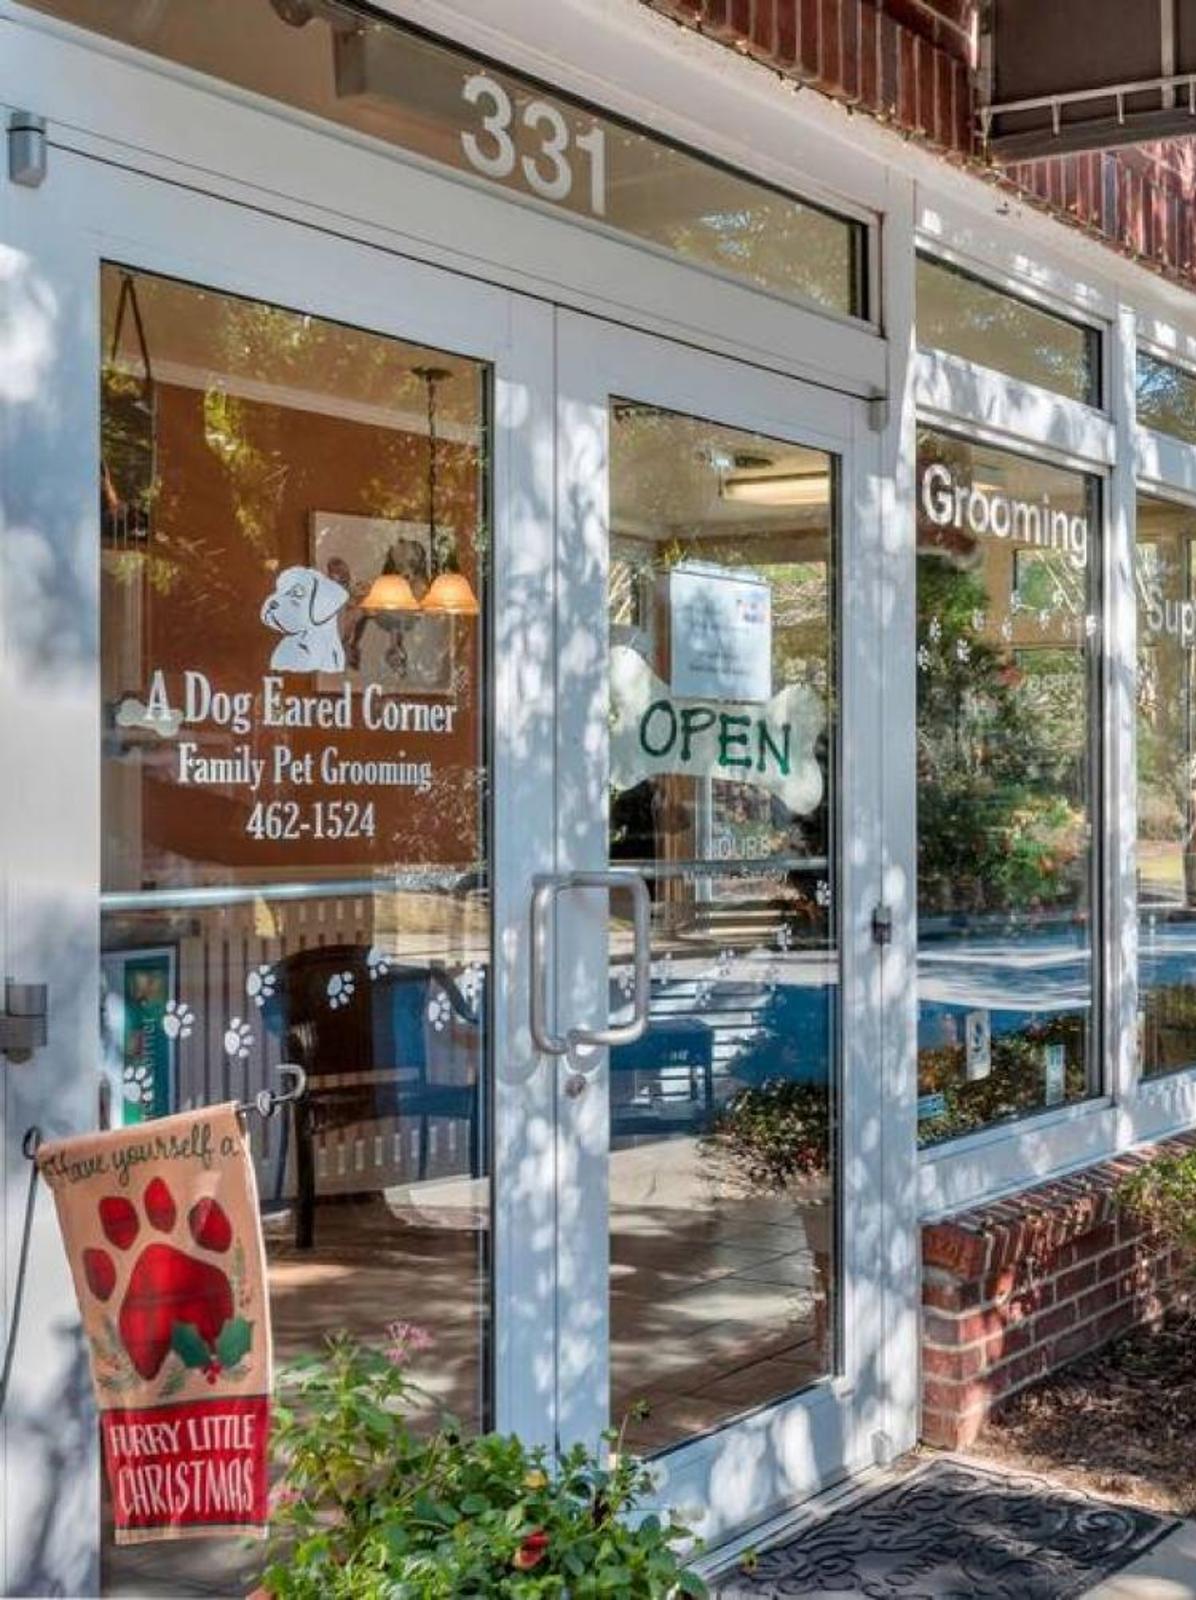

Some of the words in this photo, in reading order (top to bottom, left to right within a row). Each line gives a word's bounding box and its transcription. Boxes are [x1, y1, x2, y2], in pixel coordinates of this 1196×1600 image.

[461, 75, 605, 215] 331
[921, 464, 1088, 567] Grooming
[146, 669, 172, 722] A
[184, 670, 252, 734] Dog
[263, 676, 353, 729] Eared
[362, 684, 457, 733] Corner
[178, 742, 265, 790] Family
[274, 746, 313, 785] Pet
[321, 746, 432, 792] Grooming
[639, 700, 791, 775] OPEN
[246, 802, 376, 840] 462-1524
[112, 1123, 214, 1187] yourself
[219, 1135, 239, 1157] a
[110, 1420, 181, 1458] FURRY
[187, 1413, 256, 1450] LITTLE
[116, 1459, 255, 1517] CHRISTMAS
